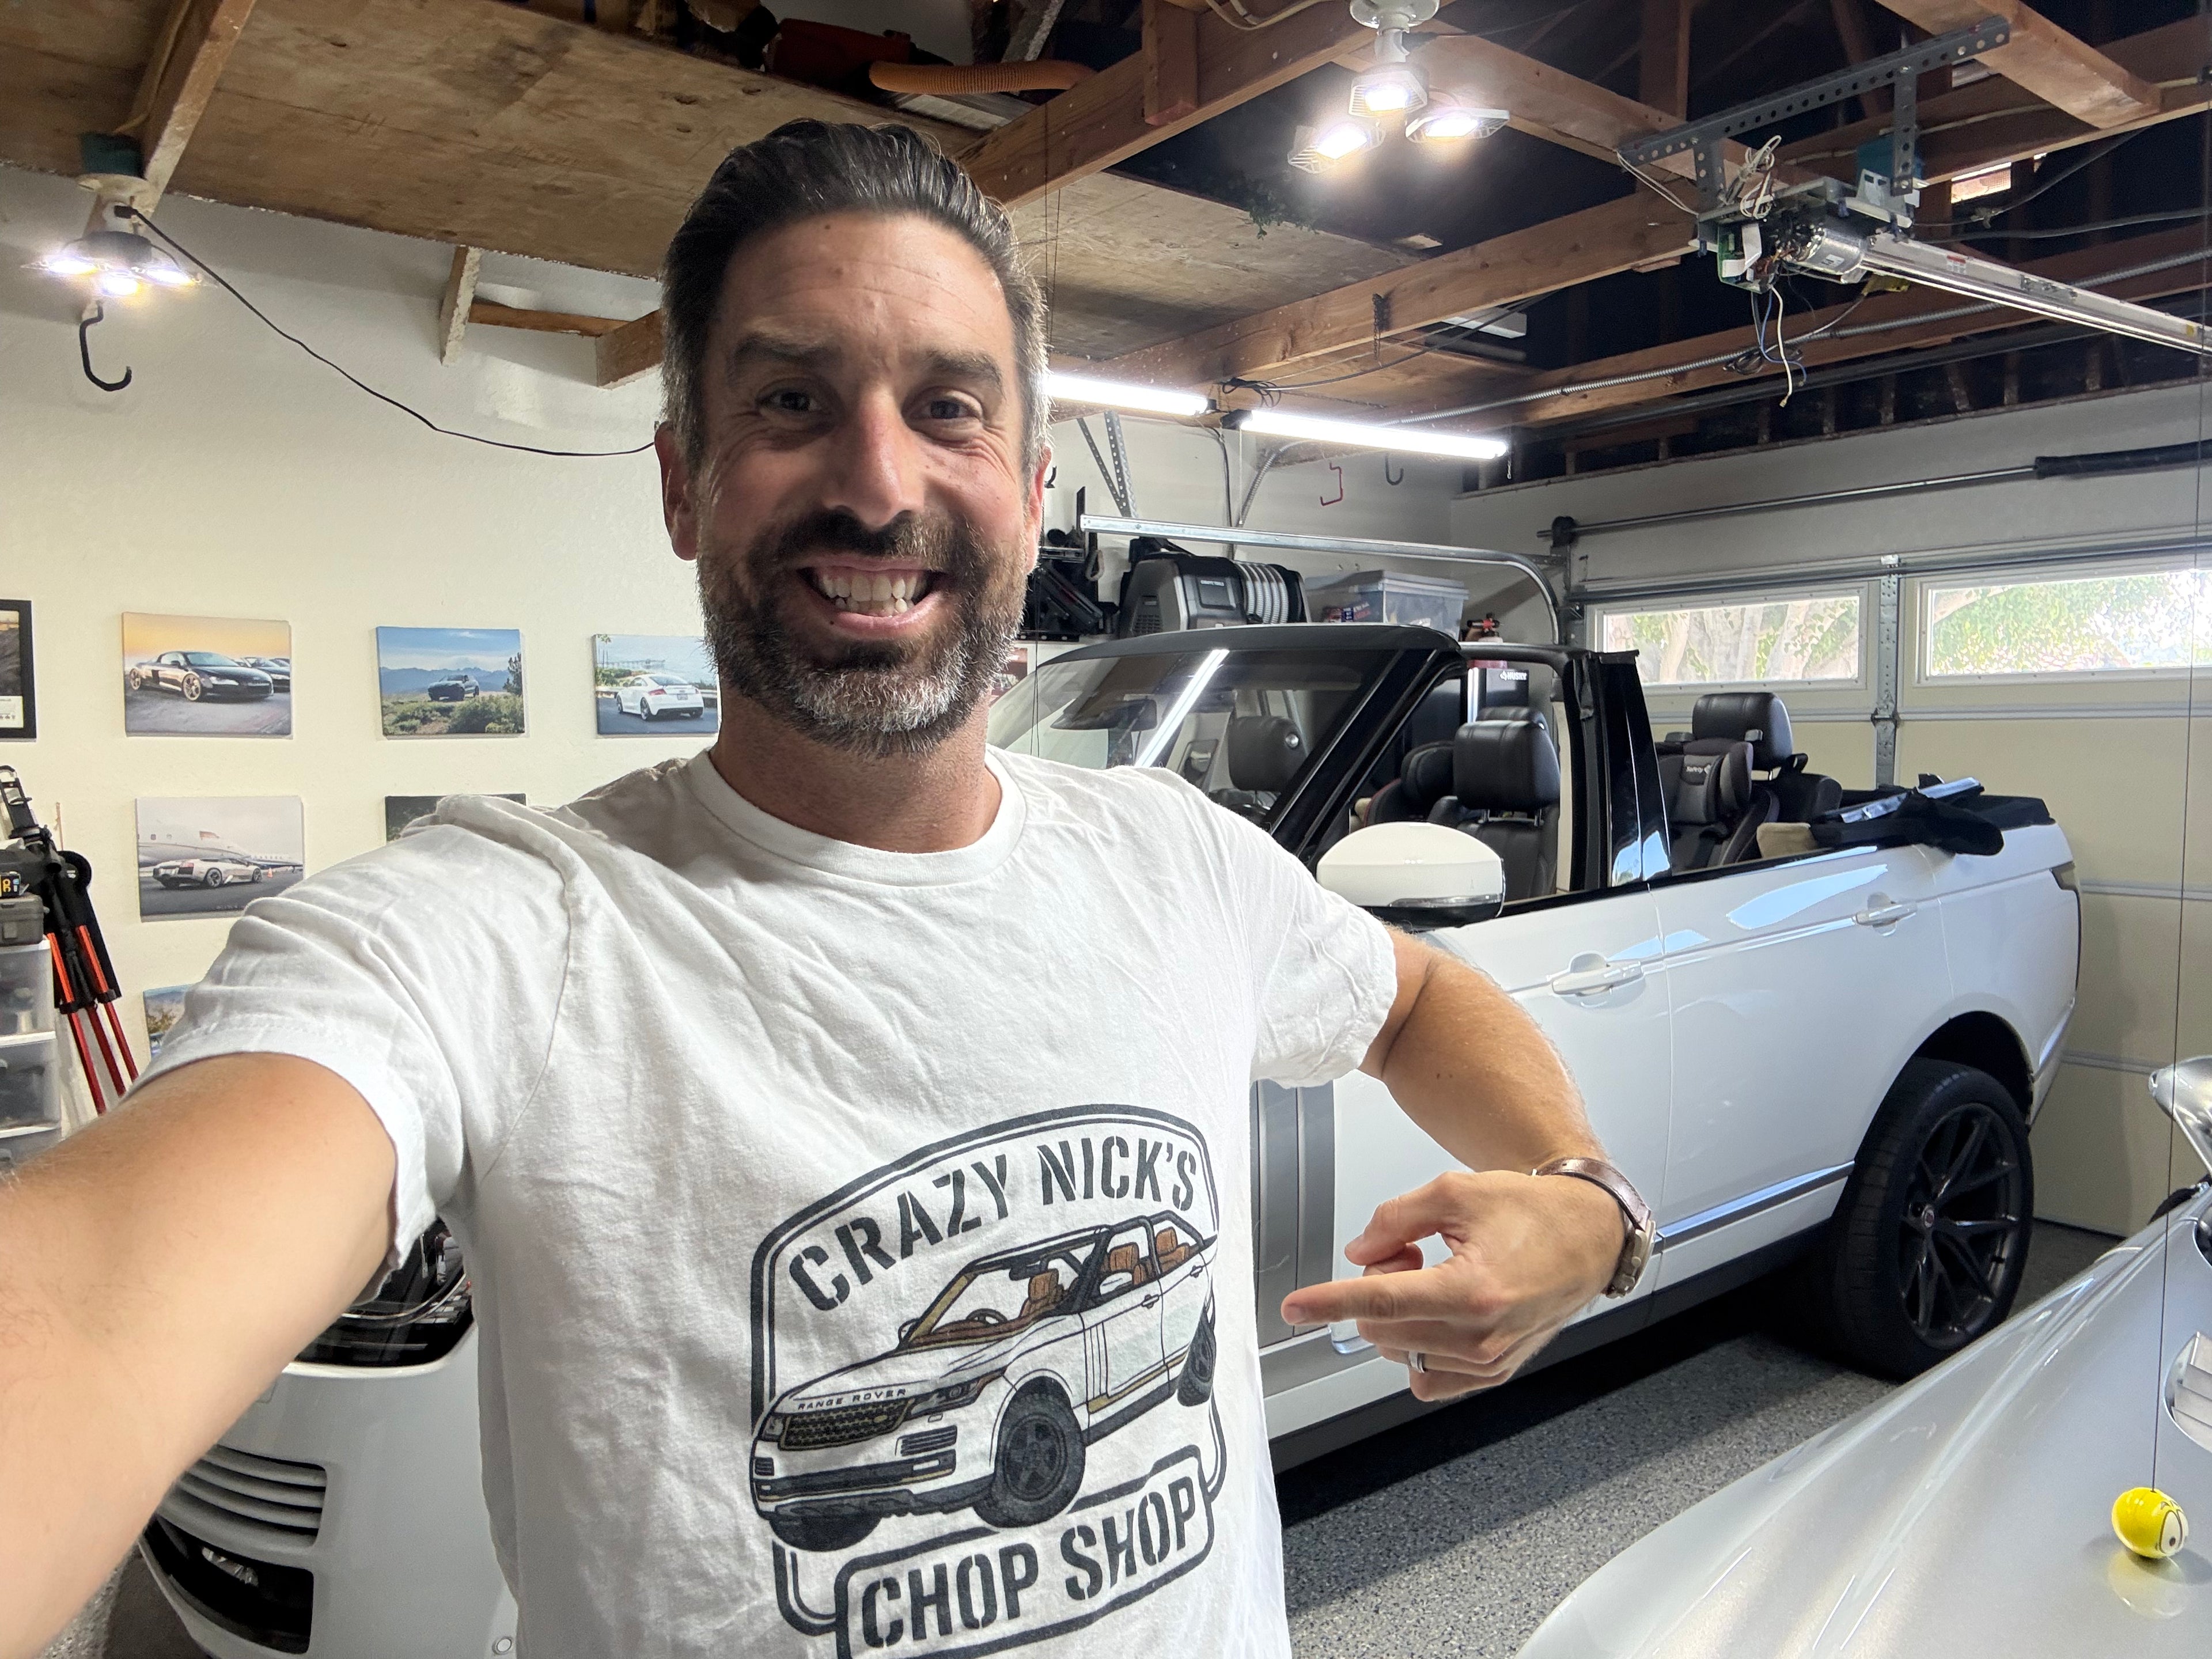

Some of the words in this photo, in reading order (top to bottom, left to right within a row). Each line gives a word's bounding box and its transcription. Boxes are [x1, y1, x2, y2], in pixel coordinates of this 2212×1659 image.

[789, 1154, 1007, 1310] CRAZY
[1038, 1136, 1196, 1211] NICK'S
[798, 1398, 843, 1410] RANGE
[853, 1389, 906, 1402] ROVER
[862, 1543, 1038, 1647] CHOP
[1061, 1476, 1196, 1600] SHOP
